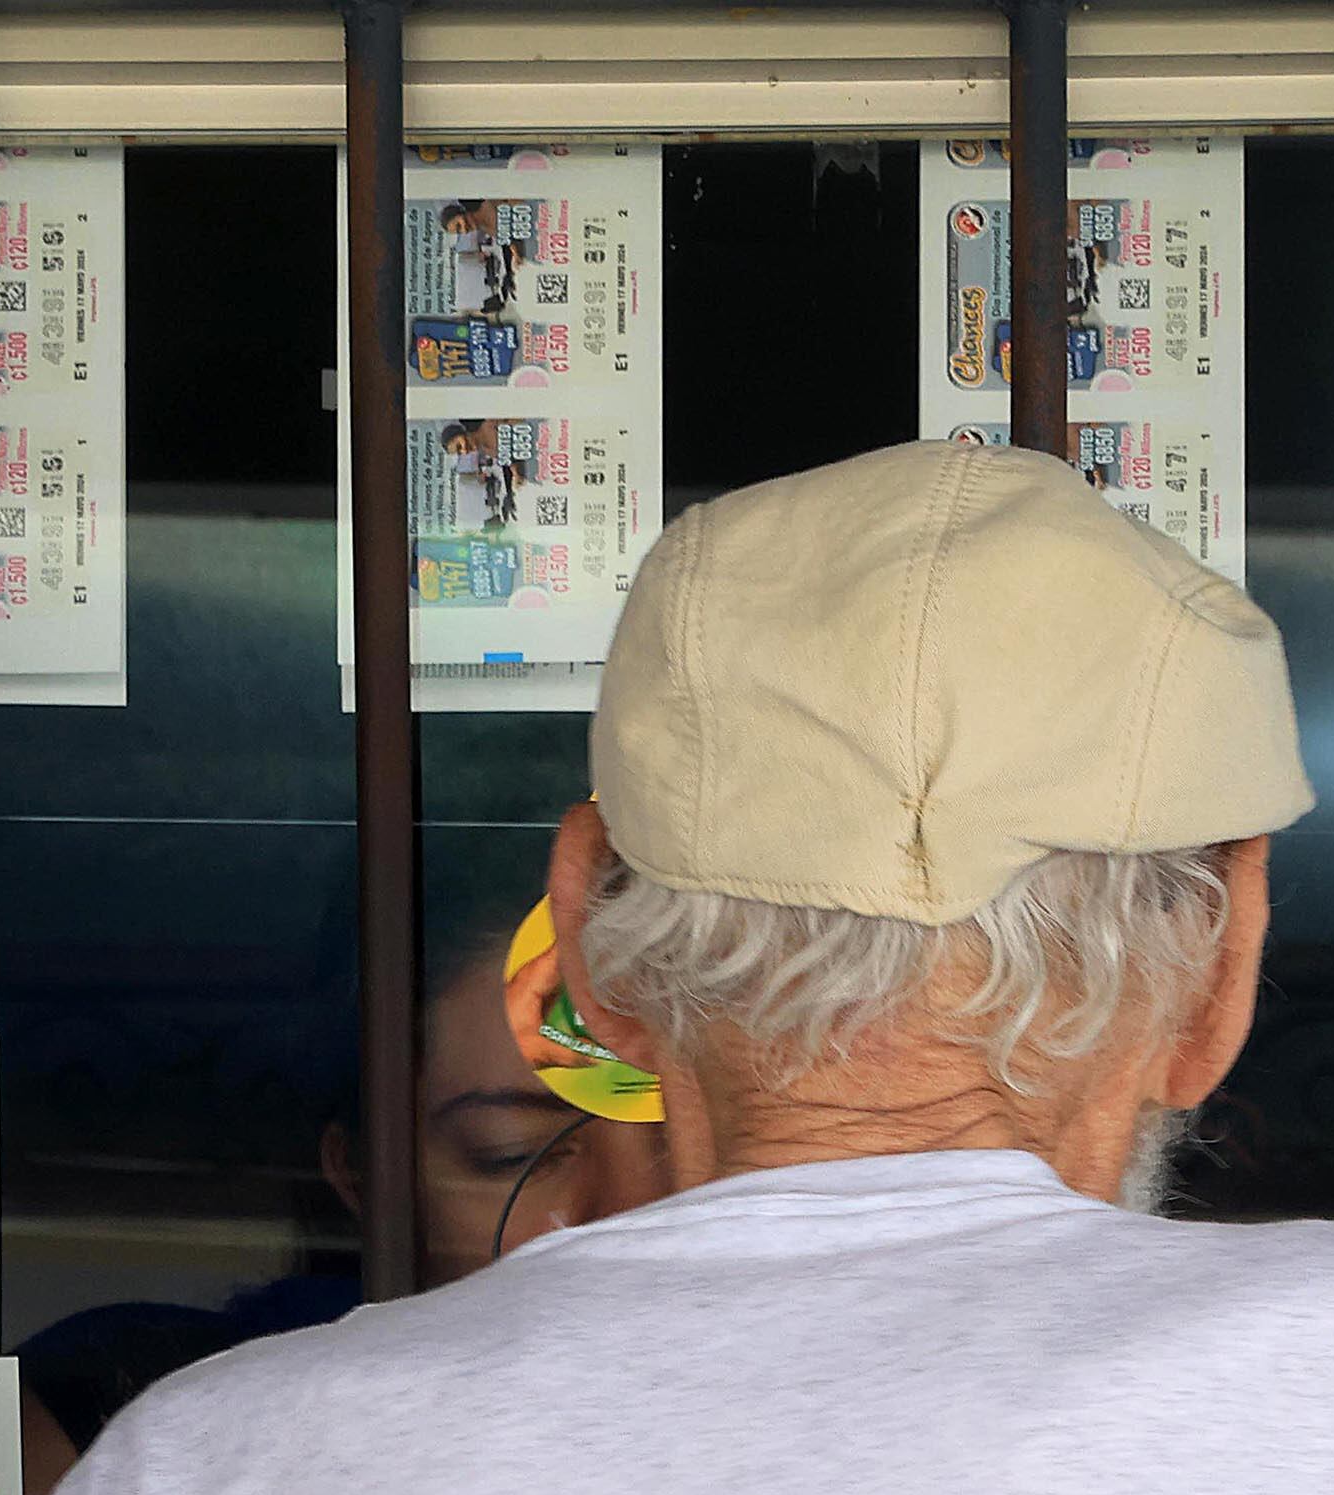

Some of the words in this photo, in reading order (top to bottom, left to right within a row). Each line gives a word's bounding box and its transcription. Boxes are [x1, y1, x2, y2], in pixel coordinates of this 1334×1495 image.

[512, 204, 531, 238] 6850
[949, 285, 987, 384] Chances
[1095, 429, 1114, 464] 6850
